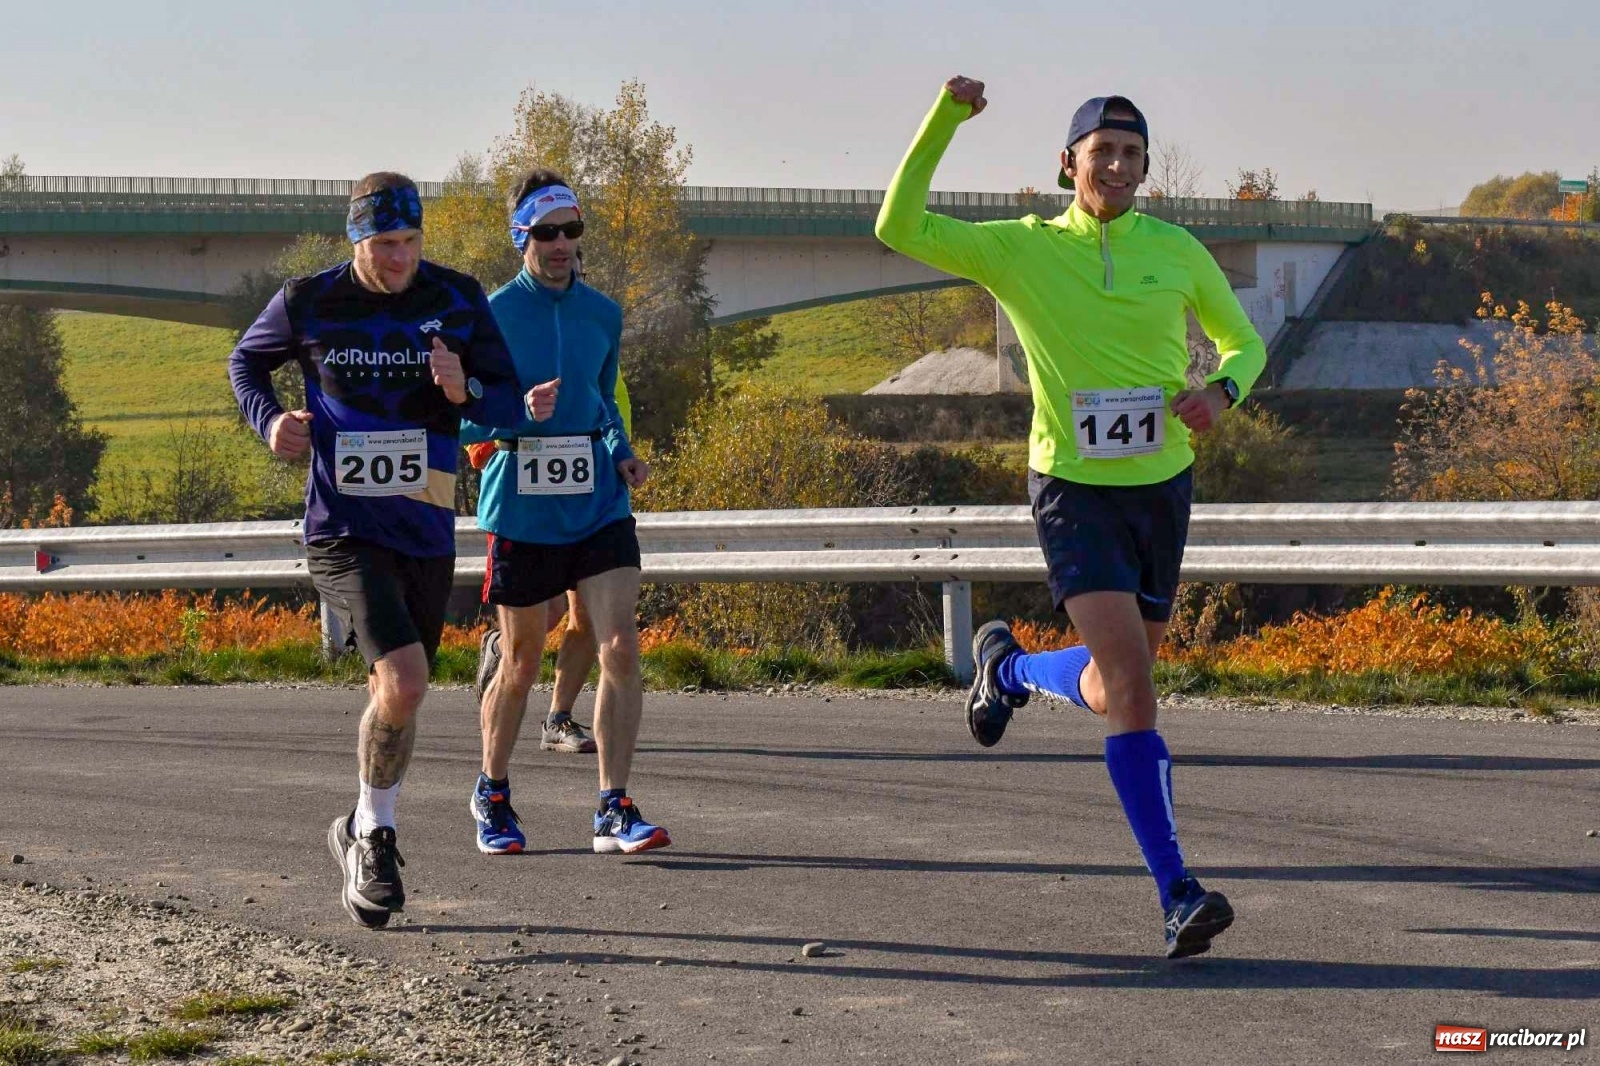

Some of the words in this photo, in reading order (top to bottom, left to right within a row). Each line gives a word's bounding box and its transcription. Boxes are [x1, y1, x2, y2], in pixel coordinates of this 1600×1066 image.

[1080, 412, 1155, 446] 141
[341, 454, 422, 485] 205
[523, 457, 590, 484] 198
